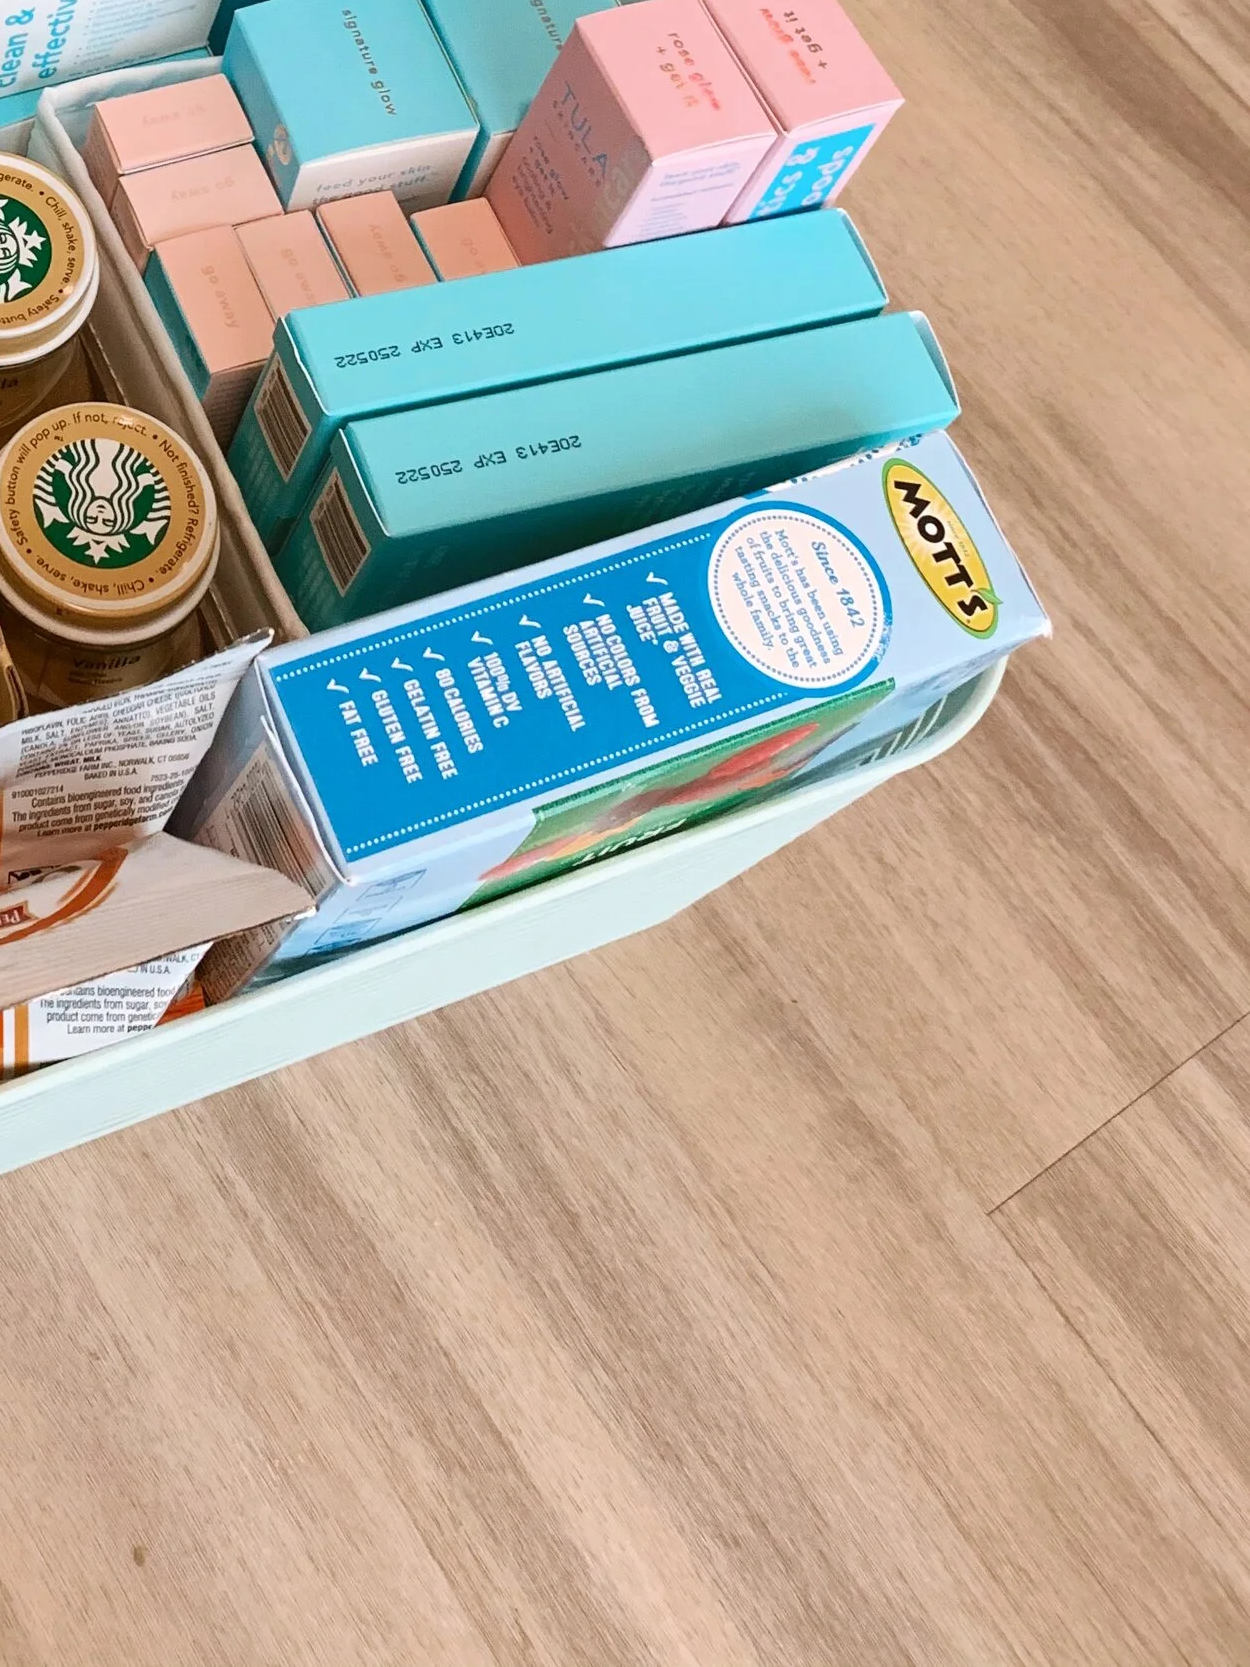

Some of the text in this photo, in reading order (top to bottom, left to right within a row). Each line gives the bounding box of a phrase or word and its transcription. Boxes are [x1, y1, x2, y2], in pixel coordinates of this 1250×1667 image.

[6, 6, 36, 27] &
[340, 8, 398, 116] signature glow
[333, 322, 515, 369] 20E413 EXP 250522
[4, 412, 109, 547] Safety button will pop up. If not,
[395, 435, 582, 485] 20E413 EXP 250522
[732, 572, 775, 651] whole family.
[734, 545, 800, 669] tasting snacks to the
[746, 536, 818, 669] of fruits to bring great
[760, 531, 831, 665] the delicious goodness
[775, 529, 844, 657] Mott's has been using
[811, 540, 866, 628] Since 1842
[484, 652, 523, 712] 100% DV
[514, 640, 553, 700] FLAVORS
[531, 635, 586, 733] NO ARTIFICIAL
[562, 624, 603, 686] SOURCES
[578, 620, 624, 692] ARTIFICIAL
[595, 613, 660, 728] NO COLORS FROM
[642, 597, 707, 709] FRUIT & VEGGIE
[658, 591, 722, 705] MADE WITH REAL
[338, 700, 379, 767] FAT FREE
[403, 678, 459, 781] GELATIN FREE
[435, 668, 484, 754] 80 CALORIES
[468, 656, 510, 729] VITAMIN C
[371, 689, 423, 784] GLUTEN FREE
[12, 797, 135, 823] The ingredients from sugar, soy,
[18, 801, 169, 832] product come from genetically modified
[31, 785, 141, 808] Contains bioengineered food
